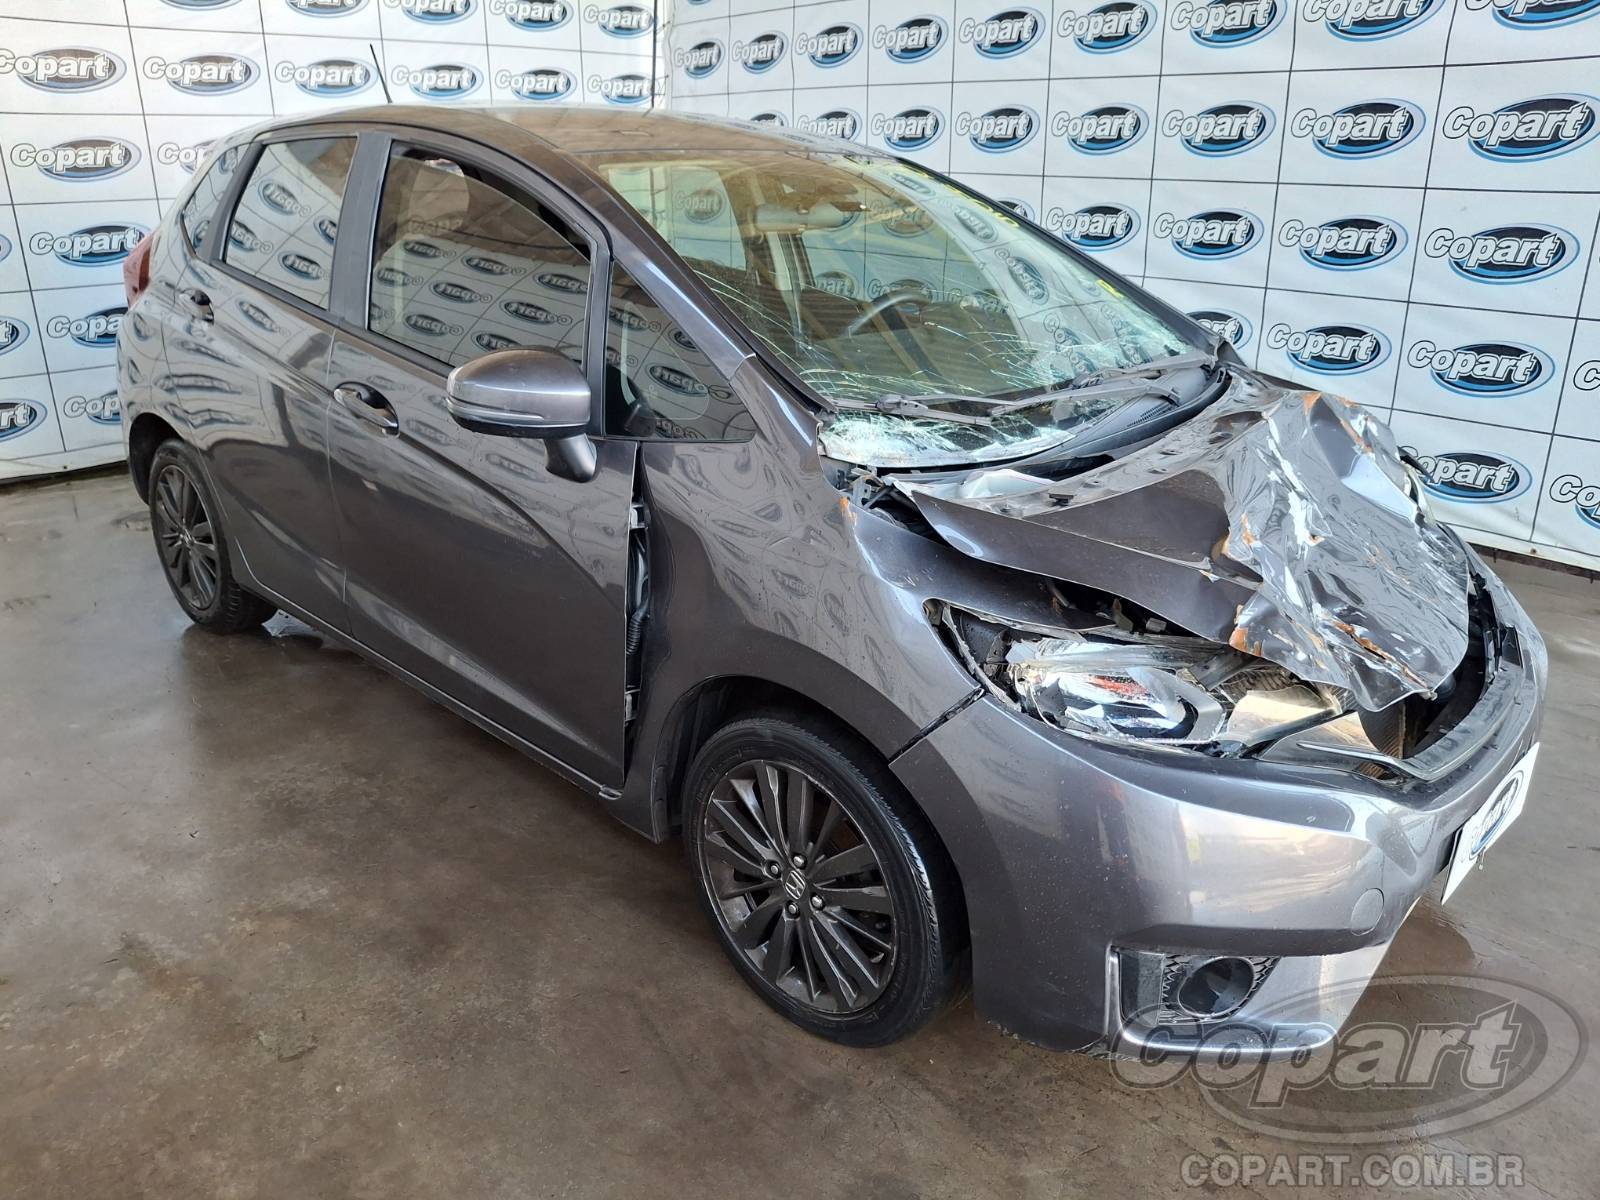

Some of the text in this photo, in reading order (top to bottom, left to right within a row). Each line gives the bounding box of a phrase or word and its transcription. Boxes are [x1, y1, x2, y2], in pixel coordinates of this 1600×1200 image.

[583, 5, 650, 28] Copart
[959, 13, 1036, 49] Copart
[1056, 2, 1145, 41] Copart
[1170, 0, 1273, 37] Copart
[732, 34, 780, 64] Copart
[796, 27, 856, 60] Copart
[873, 20, 940, 51] Copart
[143, 56, 248, 86] Copart
[674, 41, 720, 71] Copart
[274, 60, 368, 90] Copart
[391, 65, 473, 90] Copart
[495, 69, 569, 93] Copart
[586, 73, 652, 97] Copart
[871, 111, 938, 137] Copart
[955, 109, 1032, 144] Copart
[1051, 109, 1139, 144] Copart
[1162, 108, 1263, 145] Copart
[1291, 106, 1411, 147] Copart
[1443, 103, 1589, 149] Copart
[10, 142, 127, 173] Copart
[1046, 206, 1131, 239] Copart
[1153, 211, 1256, 246] Copart
[1278, 219, 1395, 257] Copart
[29, 226, 140, 259] Copart
[1424, 226, 1561, 268] Copart
[1266, 322, 1379, 362] Copart
[1407, 340, 1538, 384] Copart
